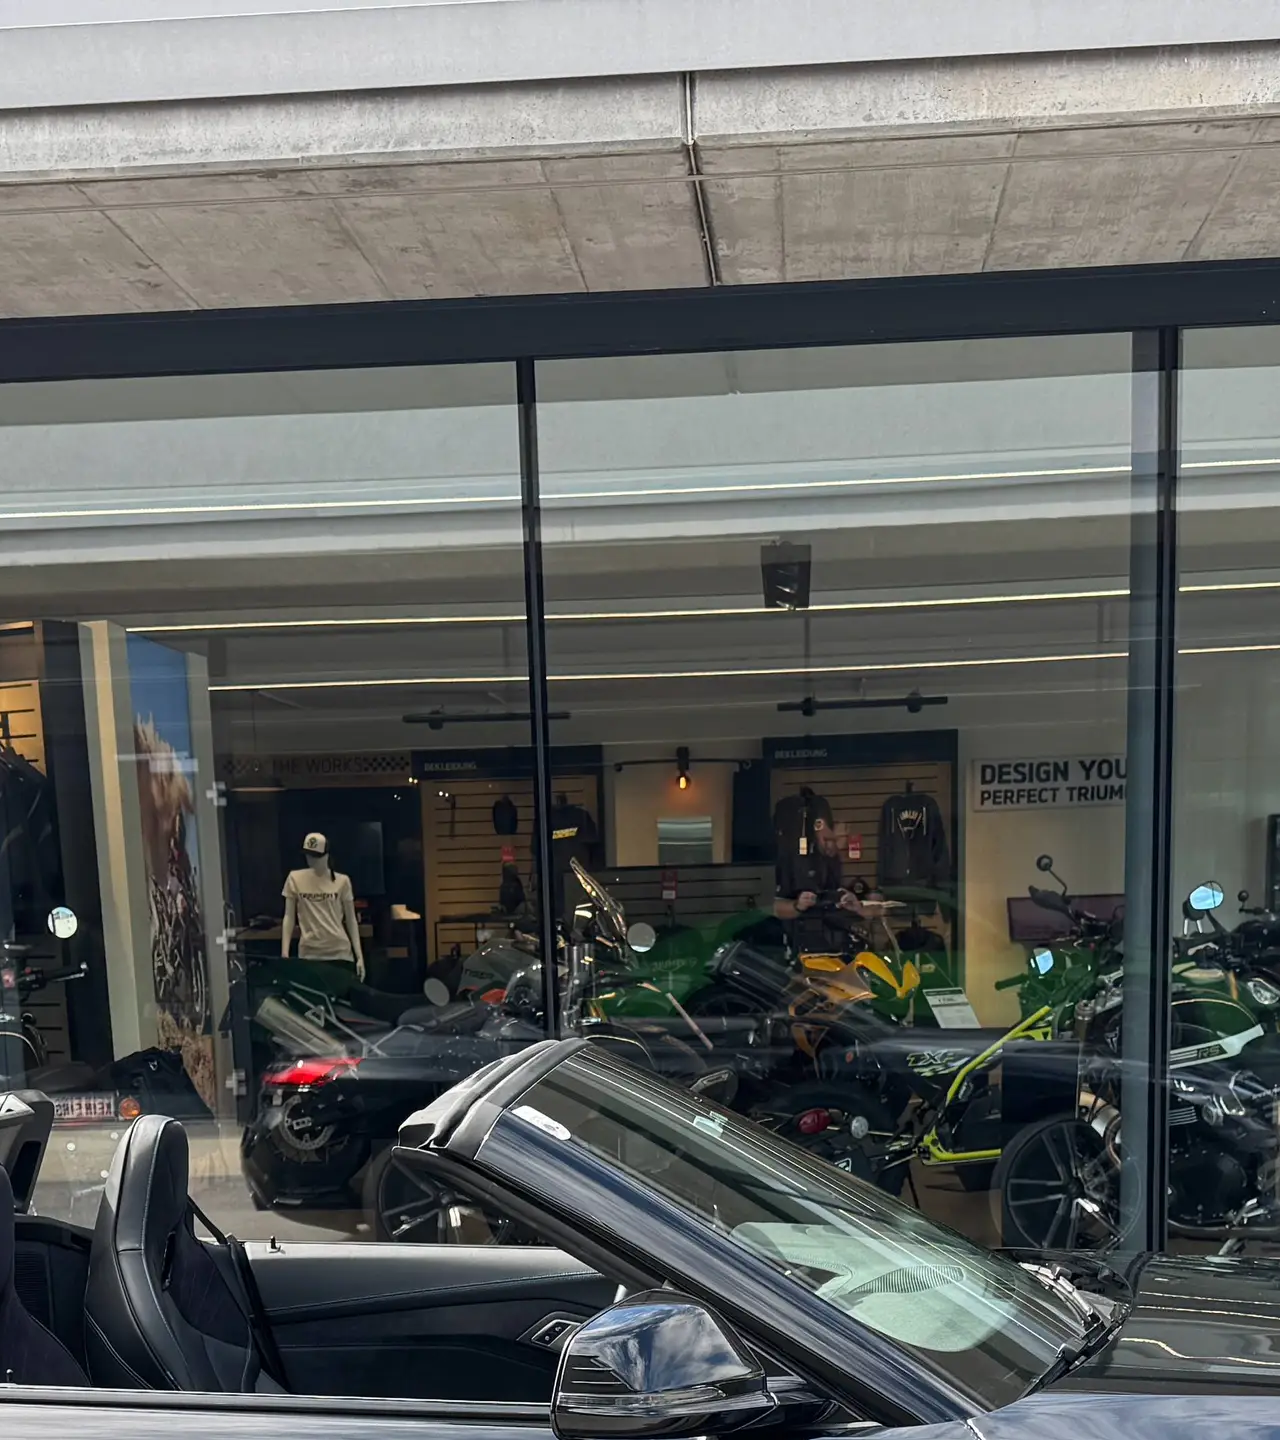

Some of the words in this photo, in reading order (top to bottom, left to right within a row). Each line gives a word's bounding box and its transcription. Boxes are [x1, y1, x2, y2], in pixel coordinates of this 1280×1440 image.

[306, 757, 363, 774] WORKS
[980, 760, 1069, 785] DESIGN
[1078, 758, 1128, 781] YOU
[980, 787, 1060, 806] PERFECT
[1066, 785, 1128, 803] TRIUM
[1198, 1045, 1220, 1058] RS
